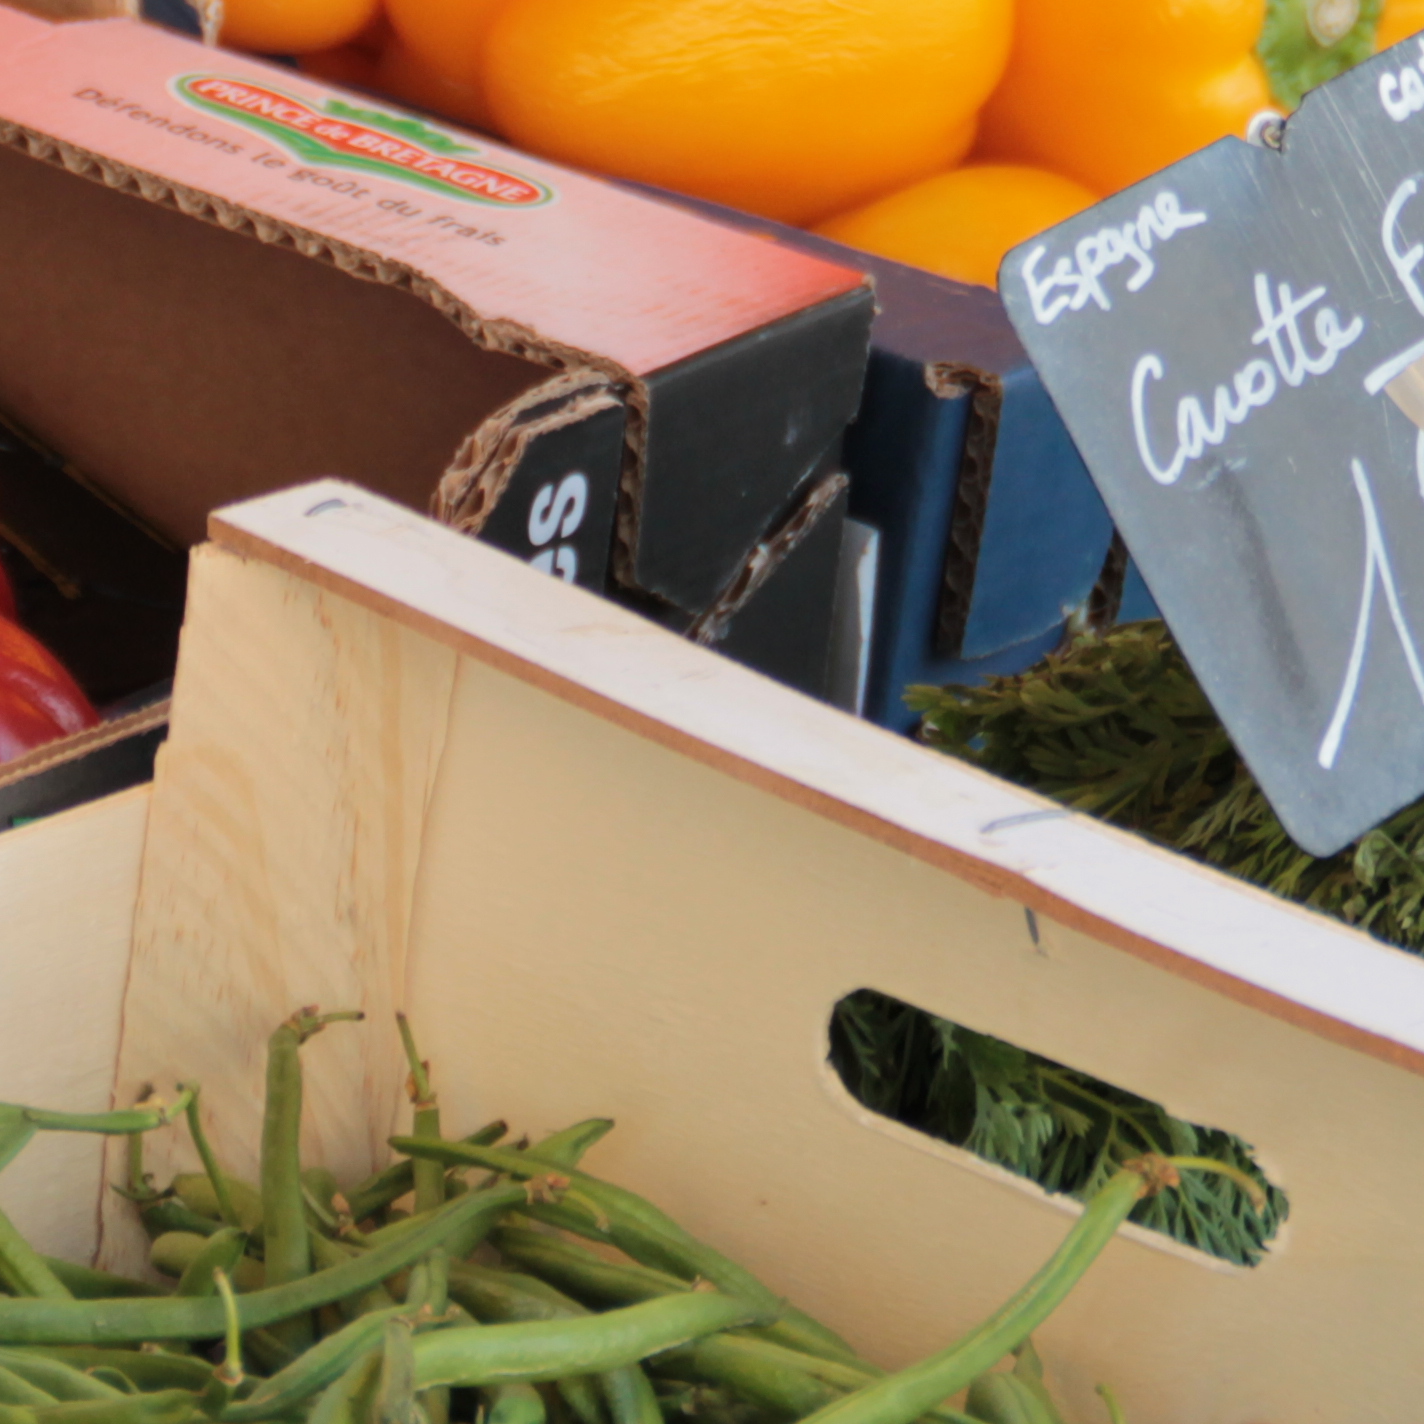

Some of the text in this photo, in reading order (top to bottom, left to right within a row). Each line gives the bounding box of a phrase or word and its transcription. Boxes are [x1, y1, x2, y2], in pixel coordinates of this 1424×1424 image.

[72, 87, 508, 247] Défendons le goût du frais
[198, 79, 531, 202] PRINCE de BRETAGNE
[1021, 190, 1207, 325] Espagne
[1131, 272, 1364, 486] Carotte
